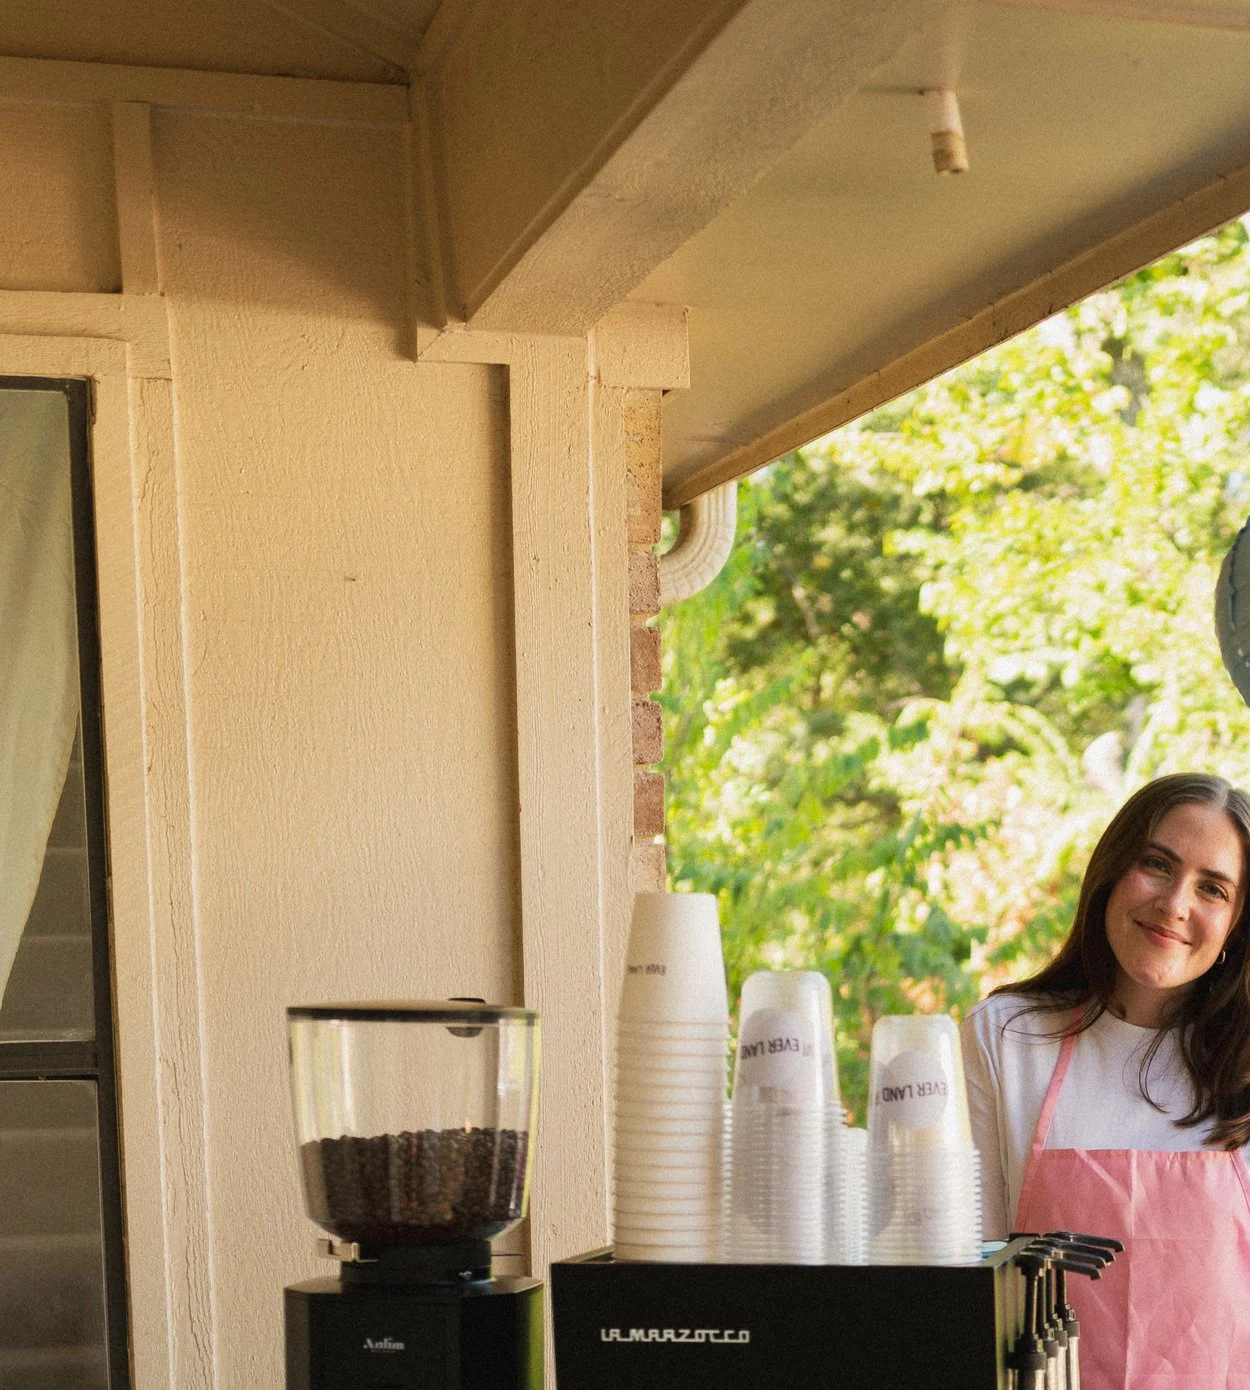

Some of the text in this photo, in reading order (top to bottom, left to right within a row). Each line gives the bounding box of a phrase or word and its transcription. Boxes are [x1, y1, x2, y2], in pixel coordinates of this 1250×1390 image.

[768, 1038, 800, 1054] EVER
[882, 1085, 913, 1102] LAND
[916, 1082, 947, 1097] EVER
[601, 1328, 622, 1342] LA
